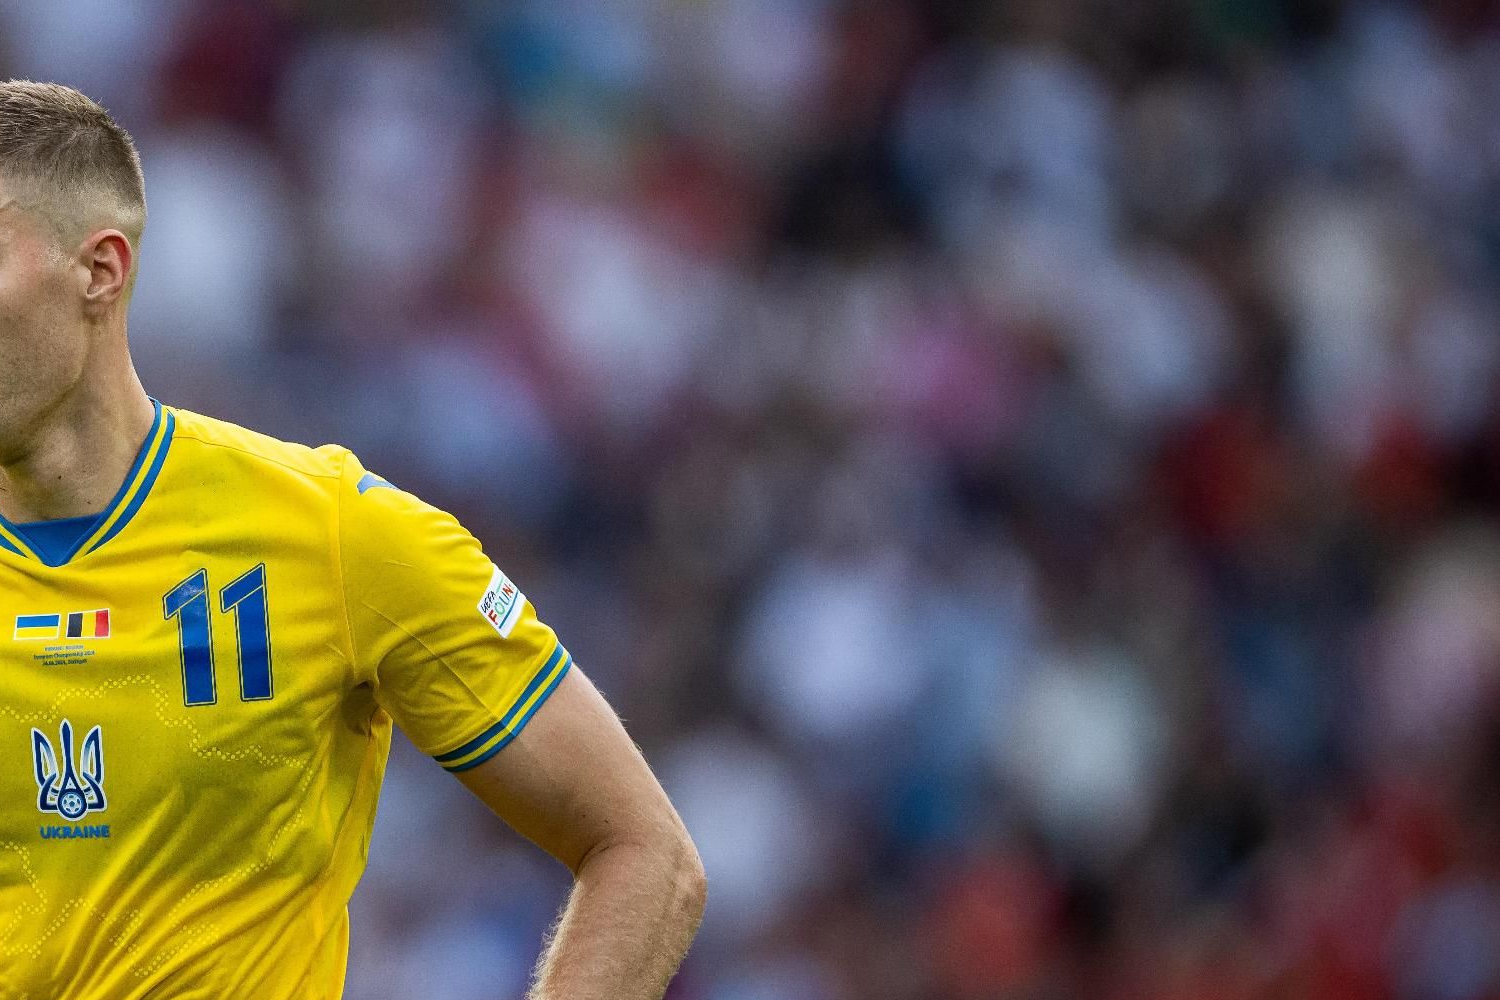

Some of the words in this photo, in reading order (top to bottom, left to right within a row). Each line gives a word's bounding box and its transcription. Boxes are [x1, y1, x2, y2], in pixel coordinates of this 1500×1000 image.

[481, 590, 496, 613] UEFA
[488, 583, 514, 625] FOUN
[162, 562, 274, 708] 11
[40, 825, 110, 840] UKRAINE
